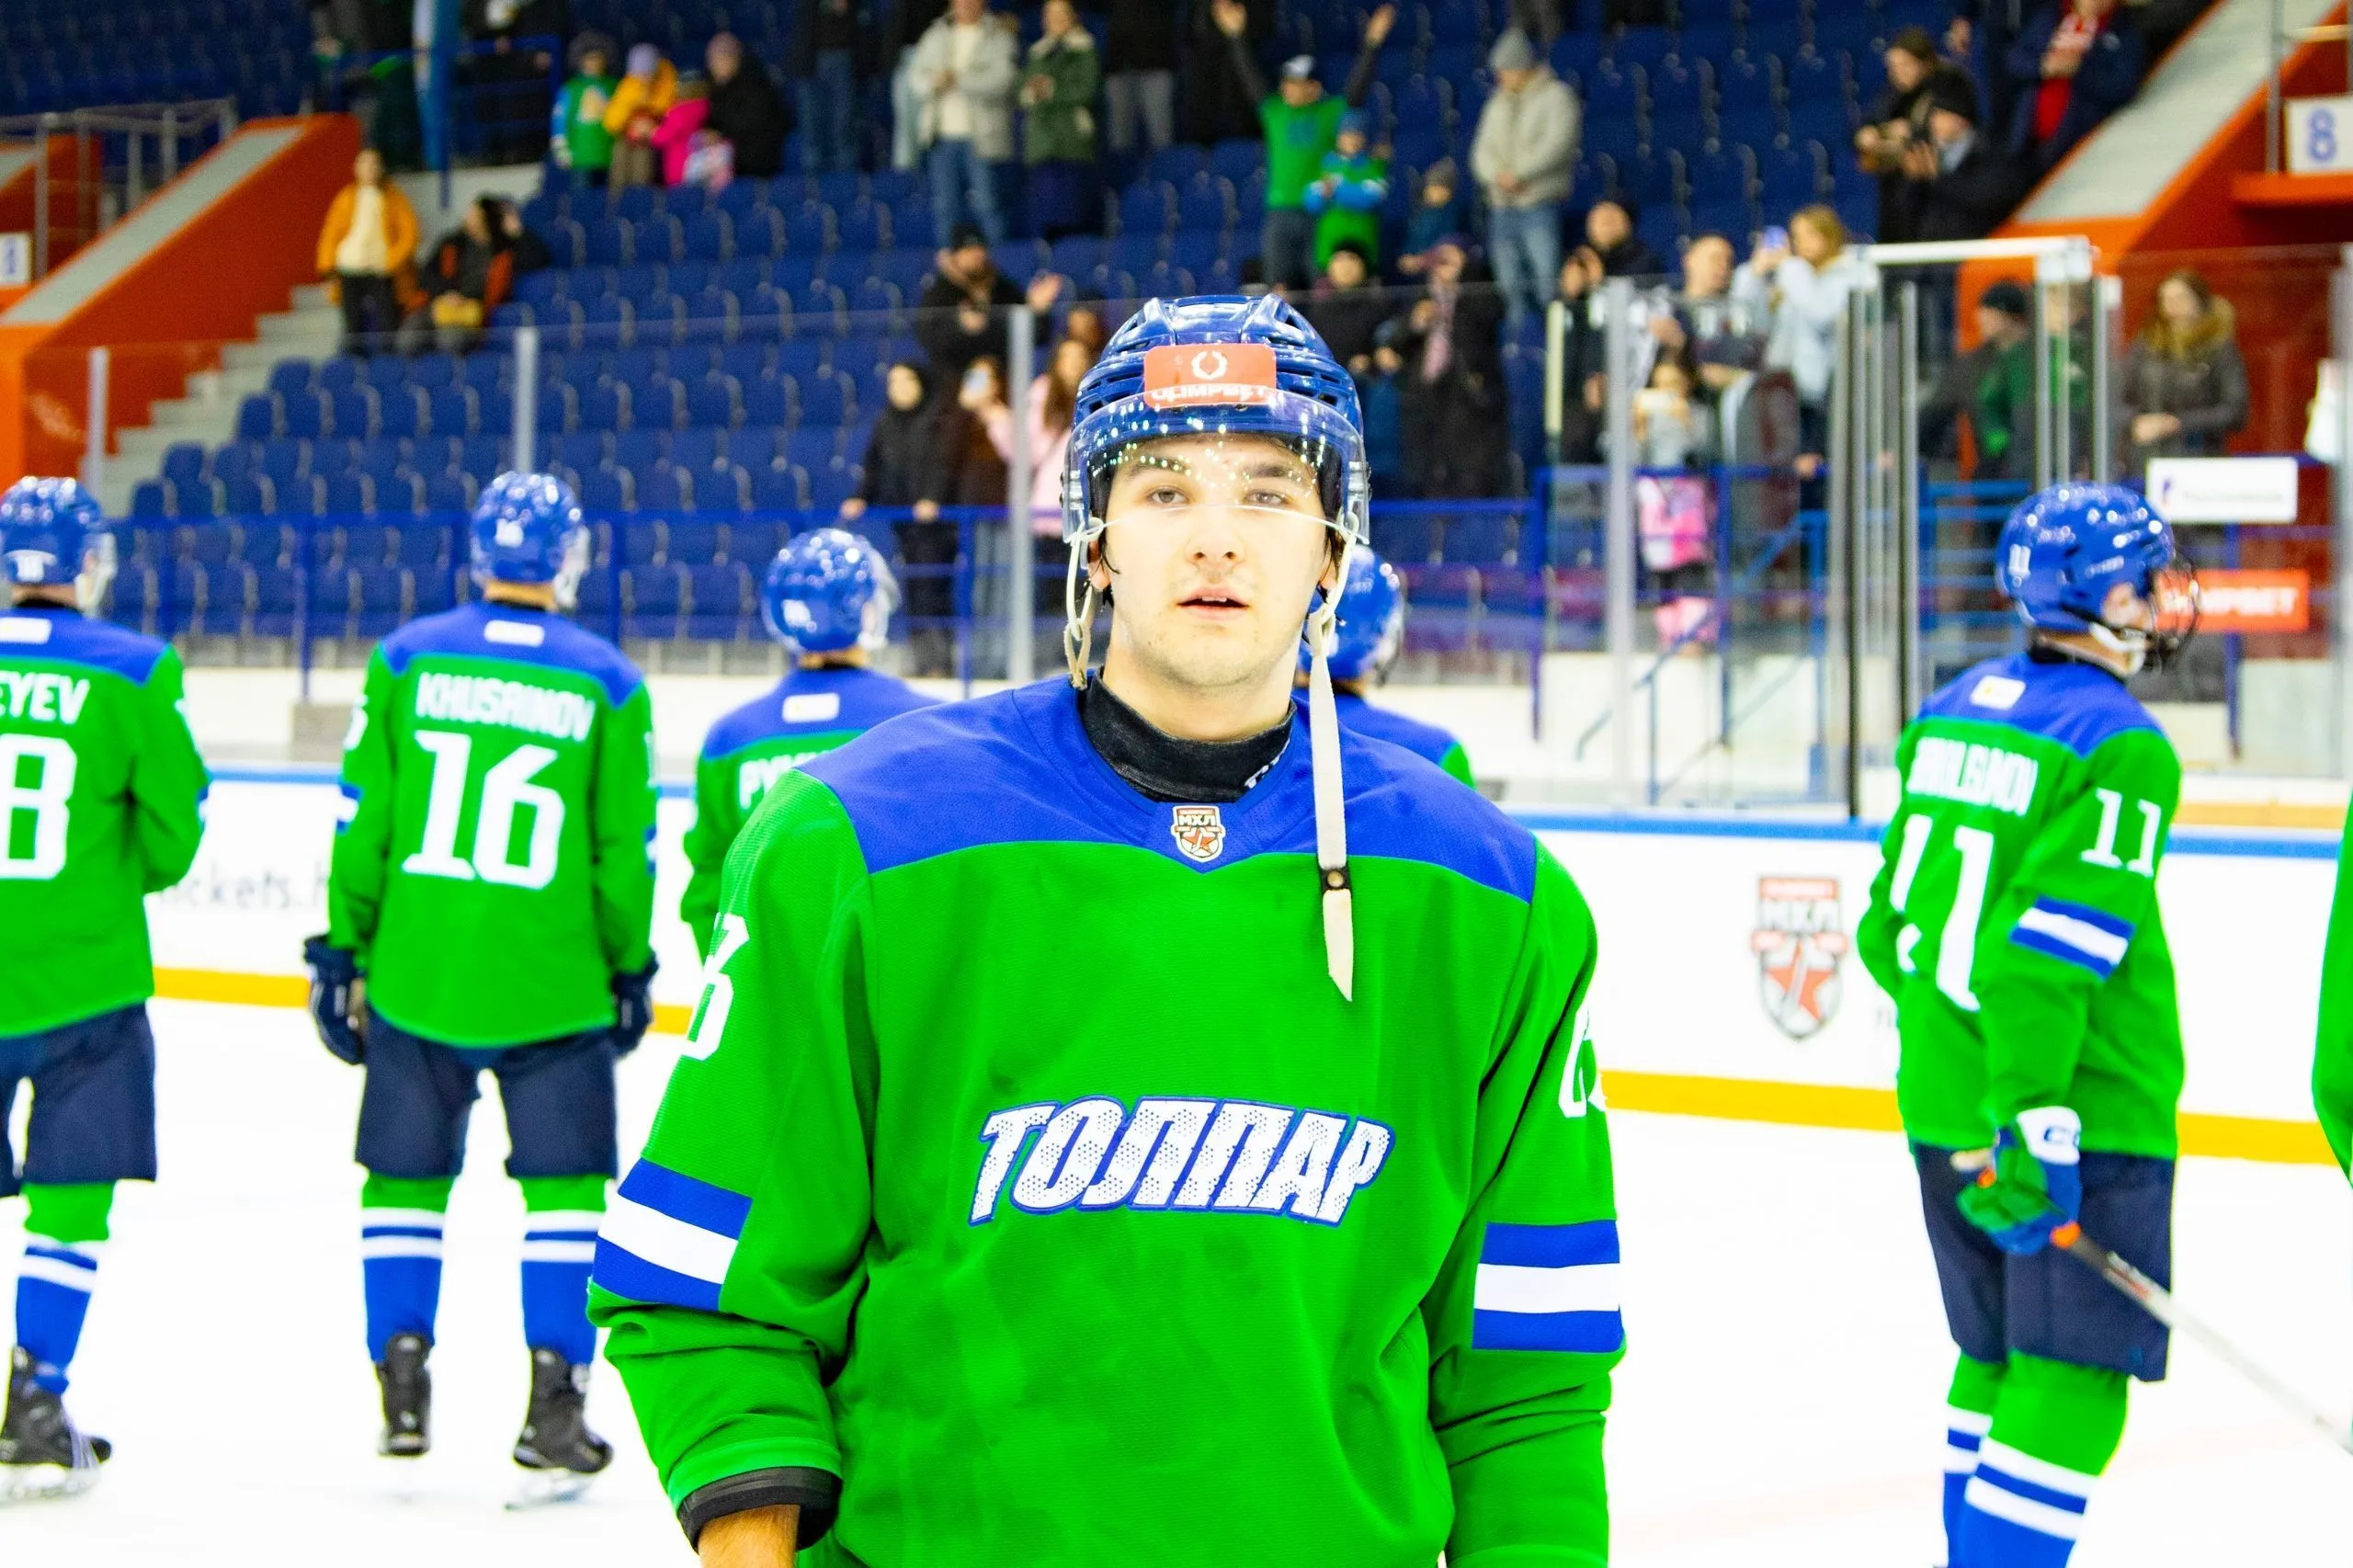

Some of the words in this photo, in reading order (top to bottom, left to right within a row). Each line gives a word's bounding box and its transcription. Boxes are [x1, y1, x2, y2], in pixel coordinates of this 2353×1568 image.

[2308, 106, 2337, 163] 8
[401, 730, 567, 891] 16
[1178, 814, 1217, 826] МХЛ
[2081, 787, 2161, 877] 11
[969, 1095, 1395, 1227] ТОЛПАР
